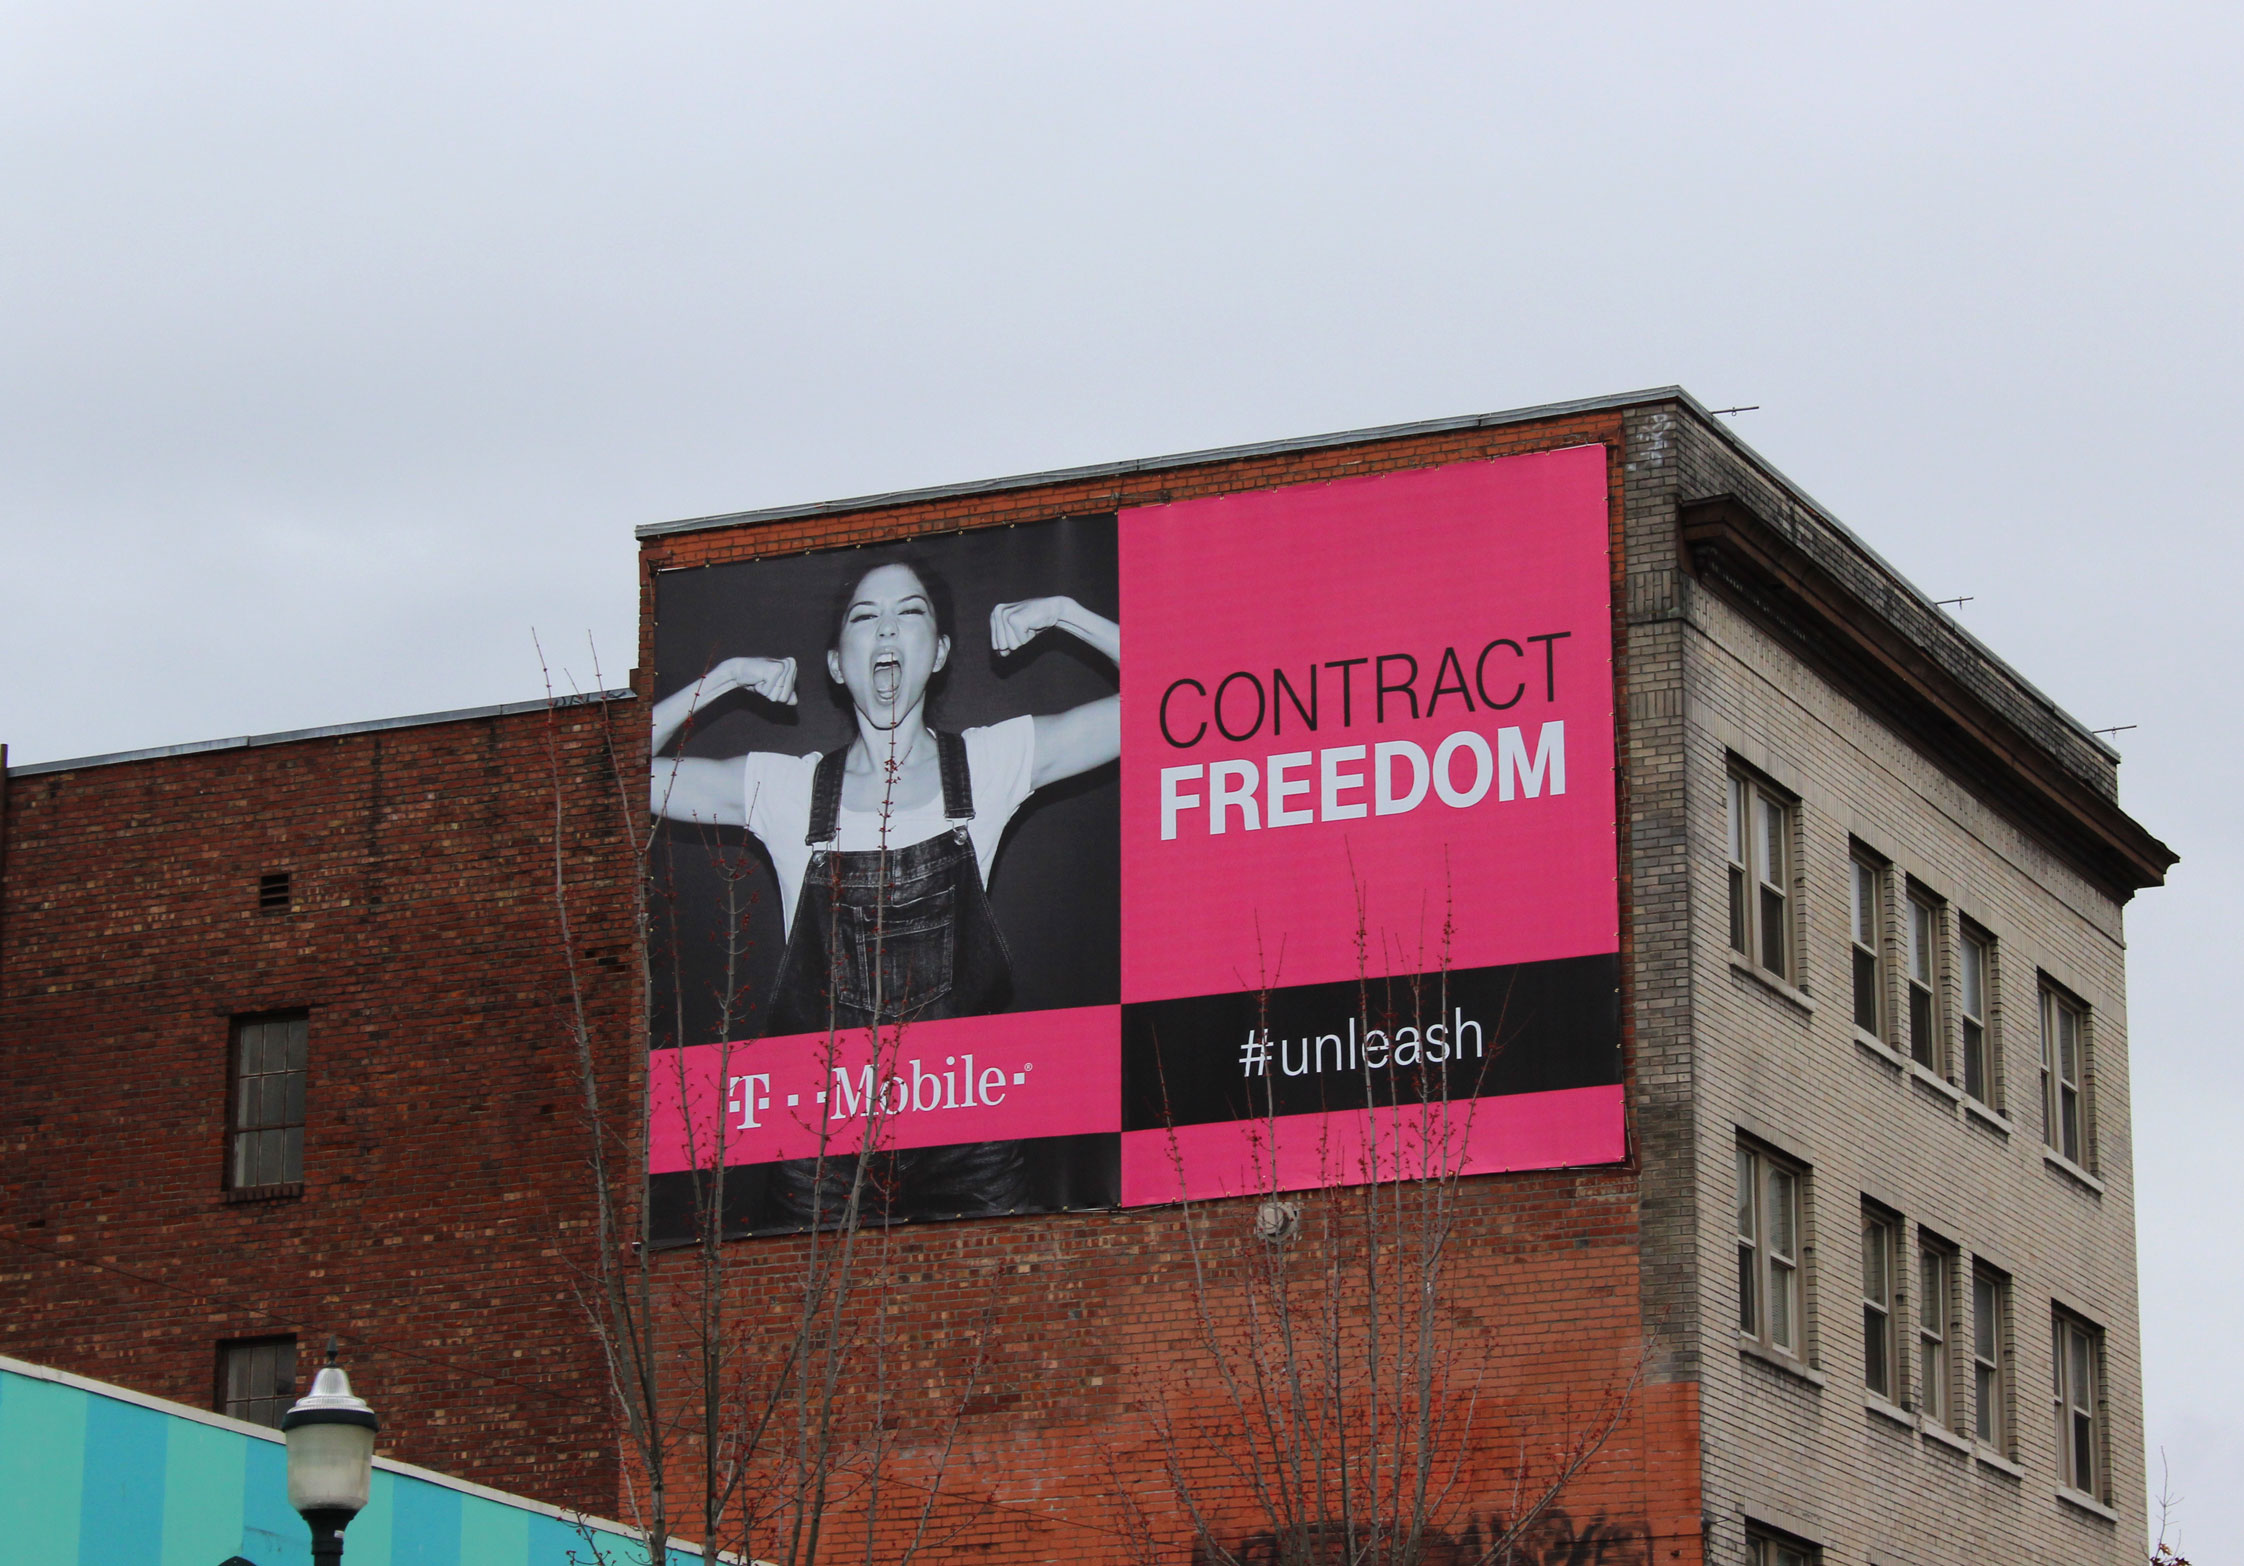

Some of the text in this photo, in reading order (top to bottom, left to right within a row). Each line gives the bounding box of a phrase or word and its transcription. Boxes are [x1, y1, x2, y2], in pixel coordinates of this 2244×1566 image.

[1159, 631, 1572, 749] CONTRACT
[1160, 719, 1566, 841] FREEDOM
[1238, 1006, 1483, 1077] #unleash
